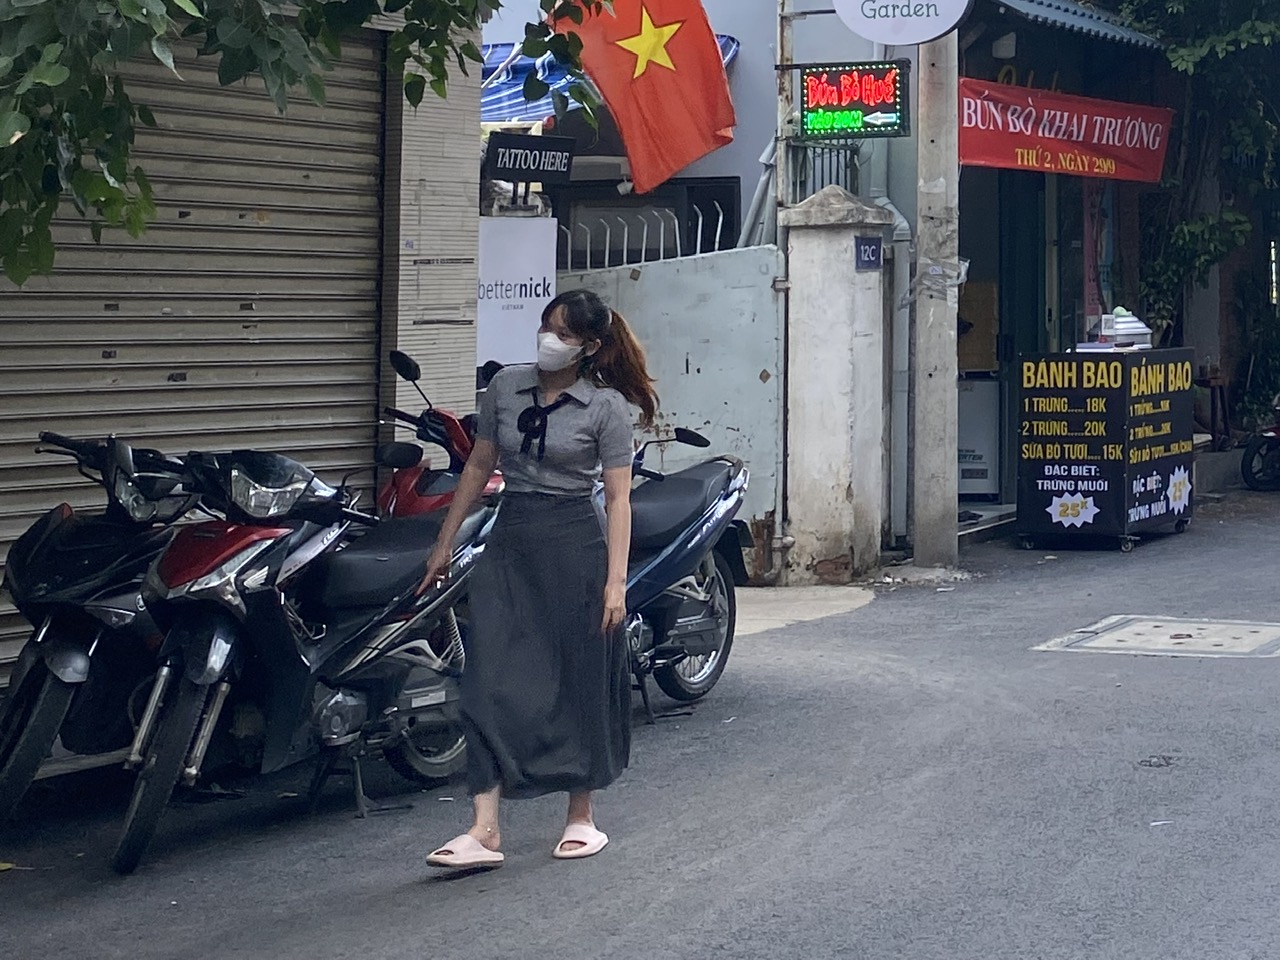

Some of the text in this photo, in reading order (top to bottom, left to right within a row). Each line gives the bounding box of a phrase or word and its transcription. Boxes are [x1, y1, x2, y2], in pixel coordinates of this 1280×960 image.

[806, 69, 896, 108] Bún Bò Huế
[962, 90, 1163, 151] BÚN BÒ KHAI TRƯƠNG
[496, 148, 570, 172] TATTOO HERE
[1015, 144, 1116, 175] THỨ 2, NGÀY 29/9
[860, 245, 876, 261] 12C
[478, 276, 552, 301] betternick
[1022, 357, 1122, 389] BÁNH BAO
[1130, 357, 1192, 397] BÁNH BAO
[1024, 397, 1029, 413] 1
[1085, 397, 1107, 413] 18K
[1022, 420, 1029, 437] 2
[1084, 420, 1107, 437] 20K
[1102, 444, 1124, 460] 15K
[1059, 500, 1089, 518] 25K
